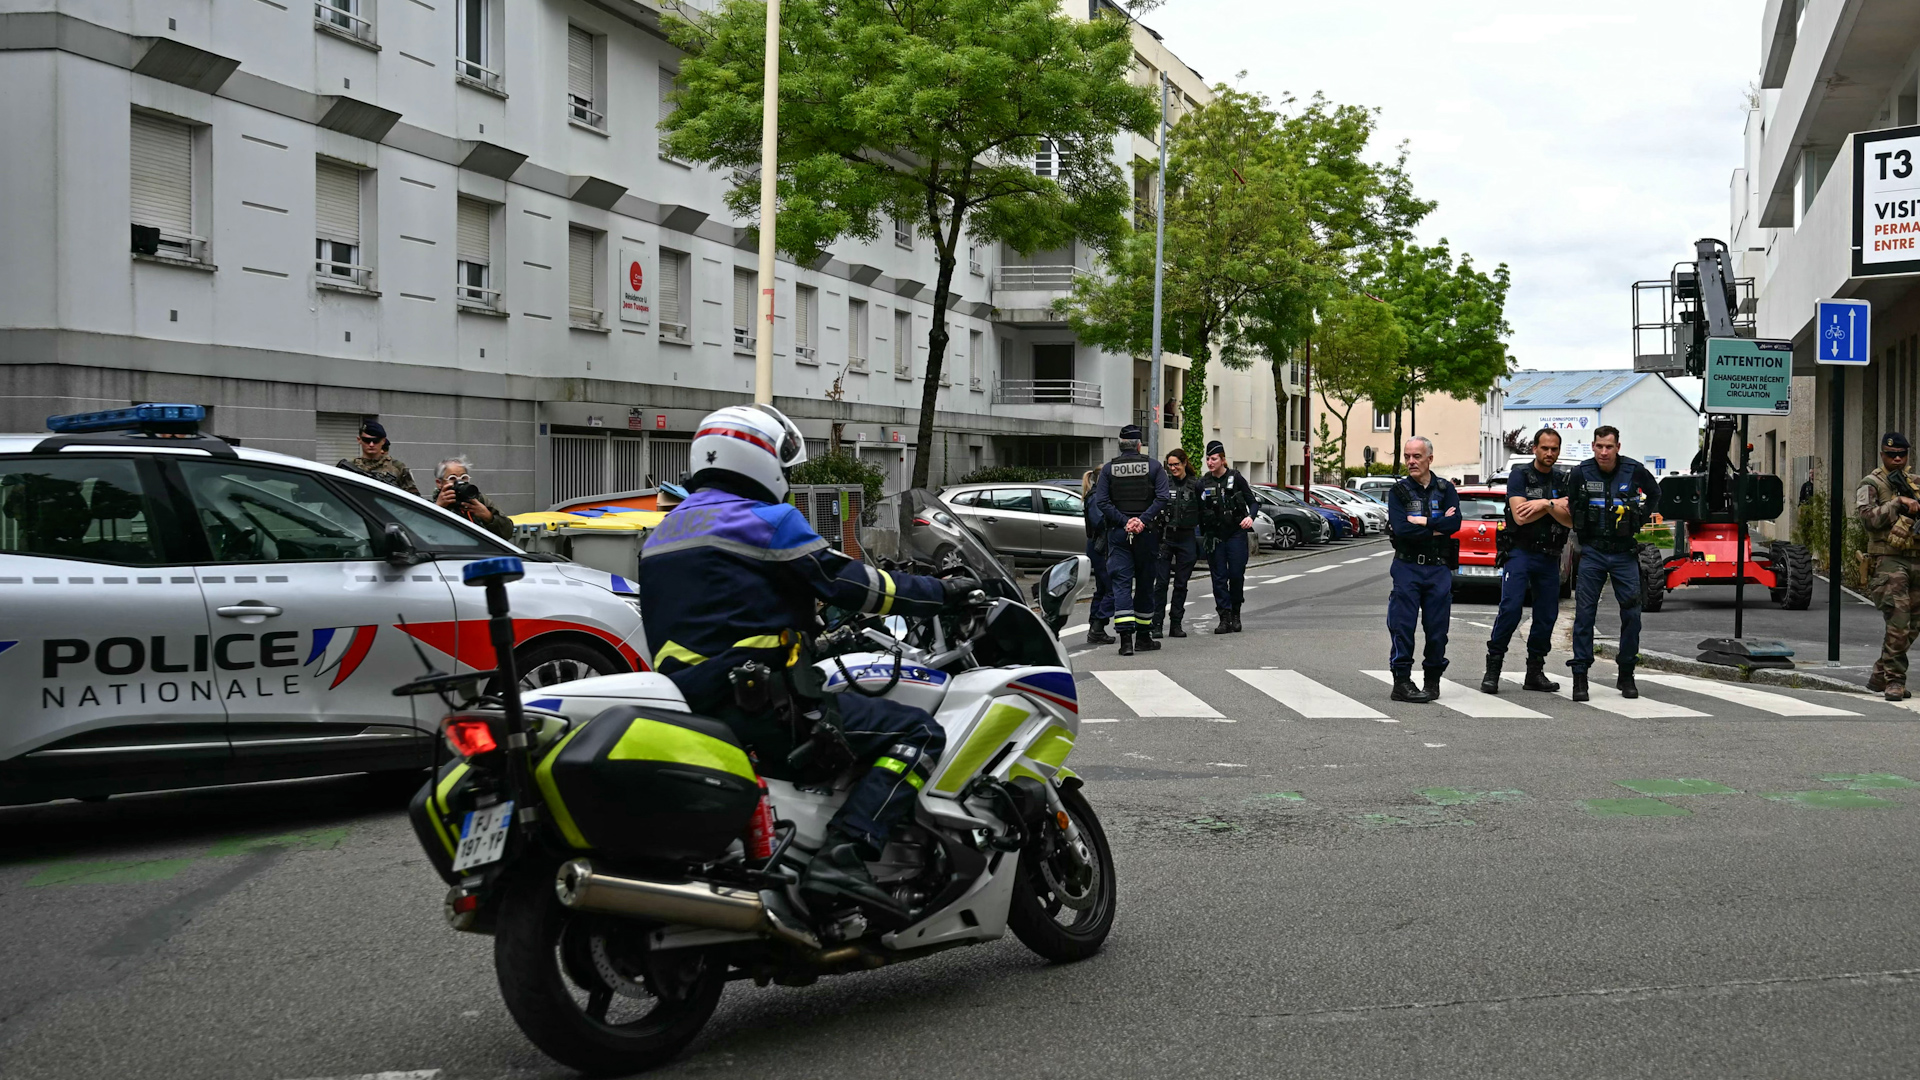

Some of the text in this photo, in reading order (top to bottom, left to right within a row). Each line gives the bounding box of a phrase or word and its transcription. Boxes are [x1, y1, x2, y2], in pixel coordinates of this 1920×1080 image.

[1875, 149, 1913, 180] T3
[1874, 199, 1920, 219] VISI
[1874, 238, 1915, 251] ENTRE
[623, 301, 633, 309] Jean
[1716, 355, 1783, 368] ATTENTION
[1714, 374, 1784, 383] CHANGEMENT RÉCENT
[1727, 390, 1769, 398] CIRCULATION
[1114, 463, 1147, 475] POLICE
[653, 508, 723, 541] OLICE
[43, 631, 299, 678] POLICE
[43, 674, 300, 708] NATIONALE
